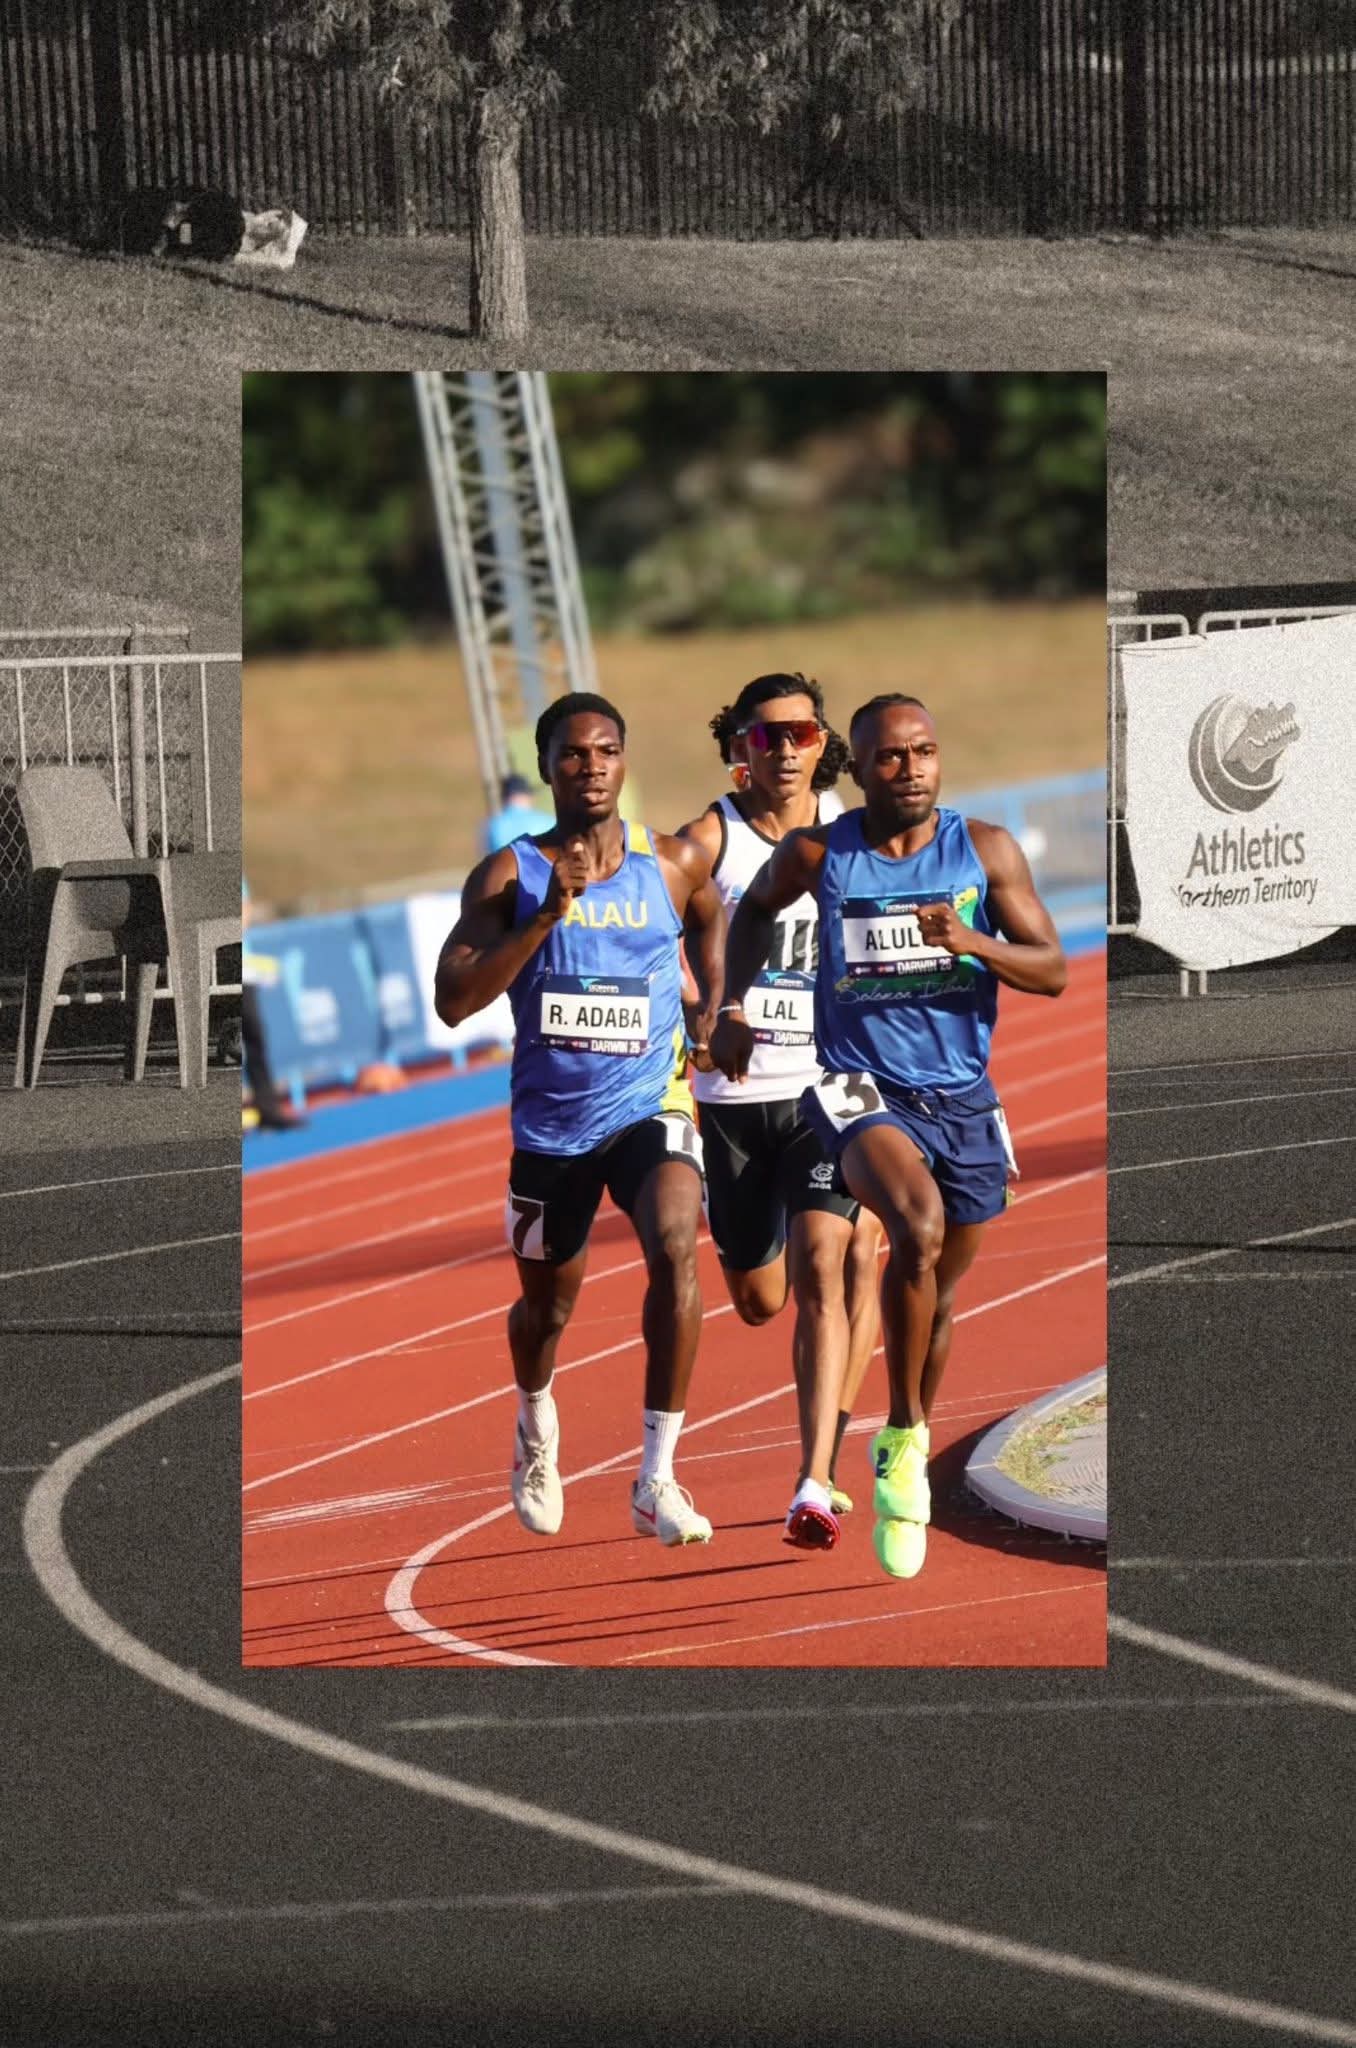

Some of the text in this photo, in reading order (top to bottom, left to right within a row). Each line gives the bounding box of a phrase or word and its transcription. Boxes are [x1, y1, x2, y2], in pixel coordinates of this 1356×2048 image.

[1186, 822, 1306, 879] Athletics
[1253, 874, 1319, 906] Territory
[563, 898, 649, 929] ALAU
[865, 927, 921, 951] ALUL
[896, 959, 937, 975] DARWIN
[549, 1004, 643, 1029] R. ADABA
[762, 999, 799, 1020] LAL
[590, 1039, 628, 1055] DARWIN
[773, 1031, 811, 1045] DARWIN
[820, 1072, 881, 1120] 3
[511, 1198, 542, 1255] 7
